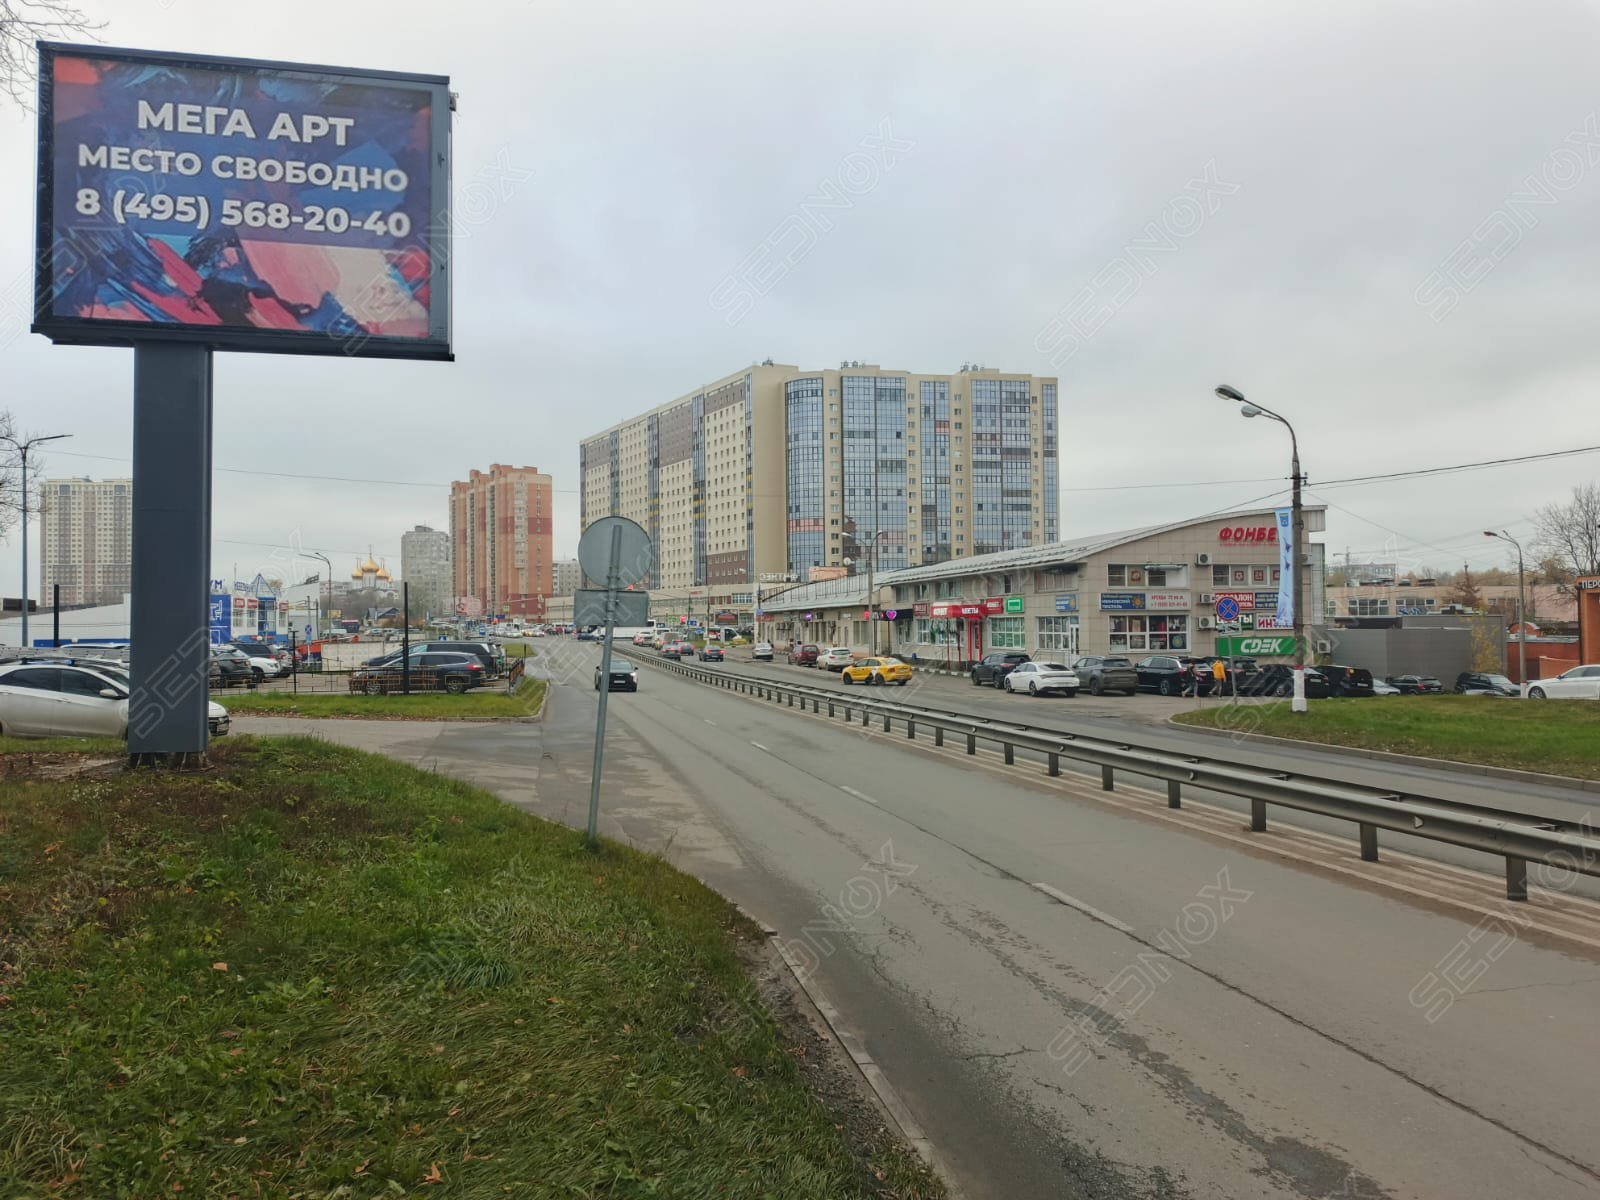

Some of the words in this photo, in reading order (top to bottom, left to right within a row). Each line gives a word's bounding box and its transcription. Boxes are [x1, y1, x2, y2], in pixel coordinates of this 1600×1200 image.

[137, 100, 256, 139] МЕГА
[267, 115, 355, 146] АРТ
[78, 143, 202, 175] МЕСТО
[211, 154, 410, 193] СВОБОДНО
[75, 188, 101, 215] 8
[113, 189, 211, 229] (495)
[220, 200, 411, 238] 568-20-40
[1219, 527, 1278, 542] ФОНБЕ
